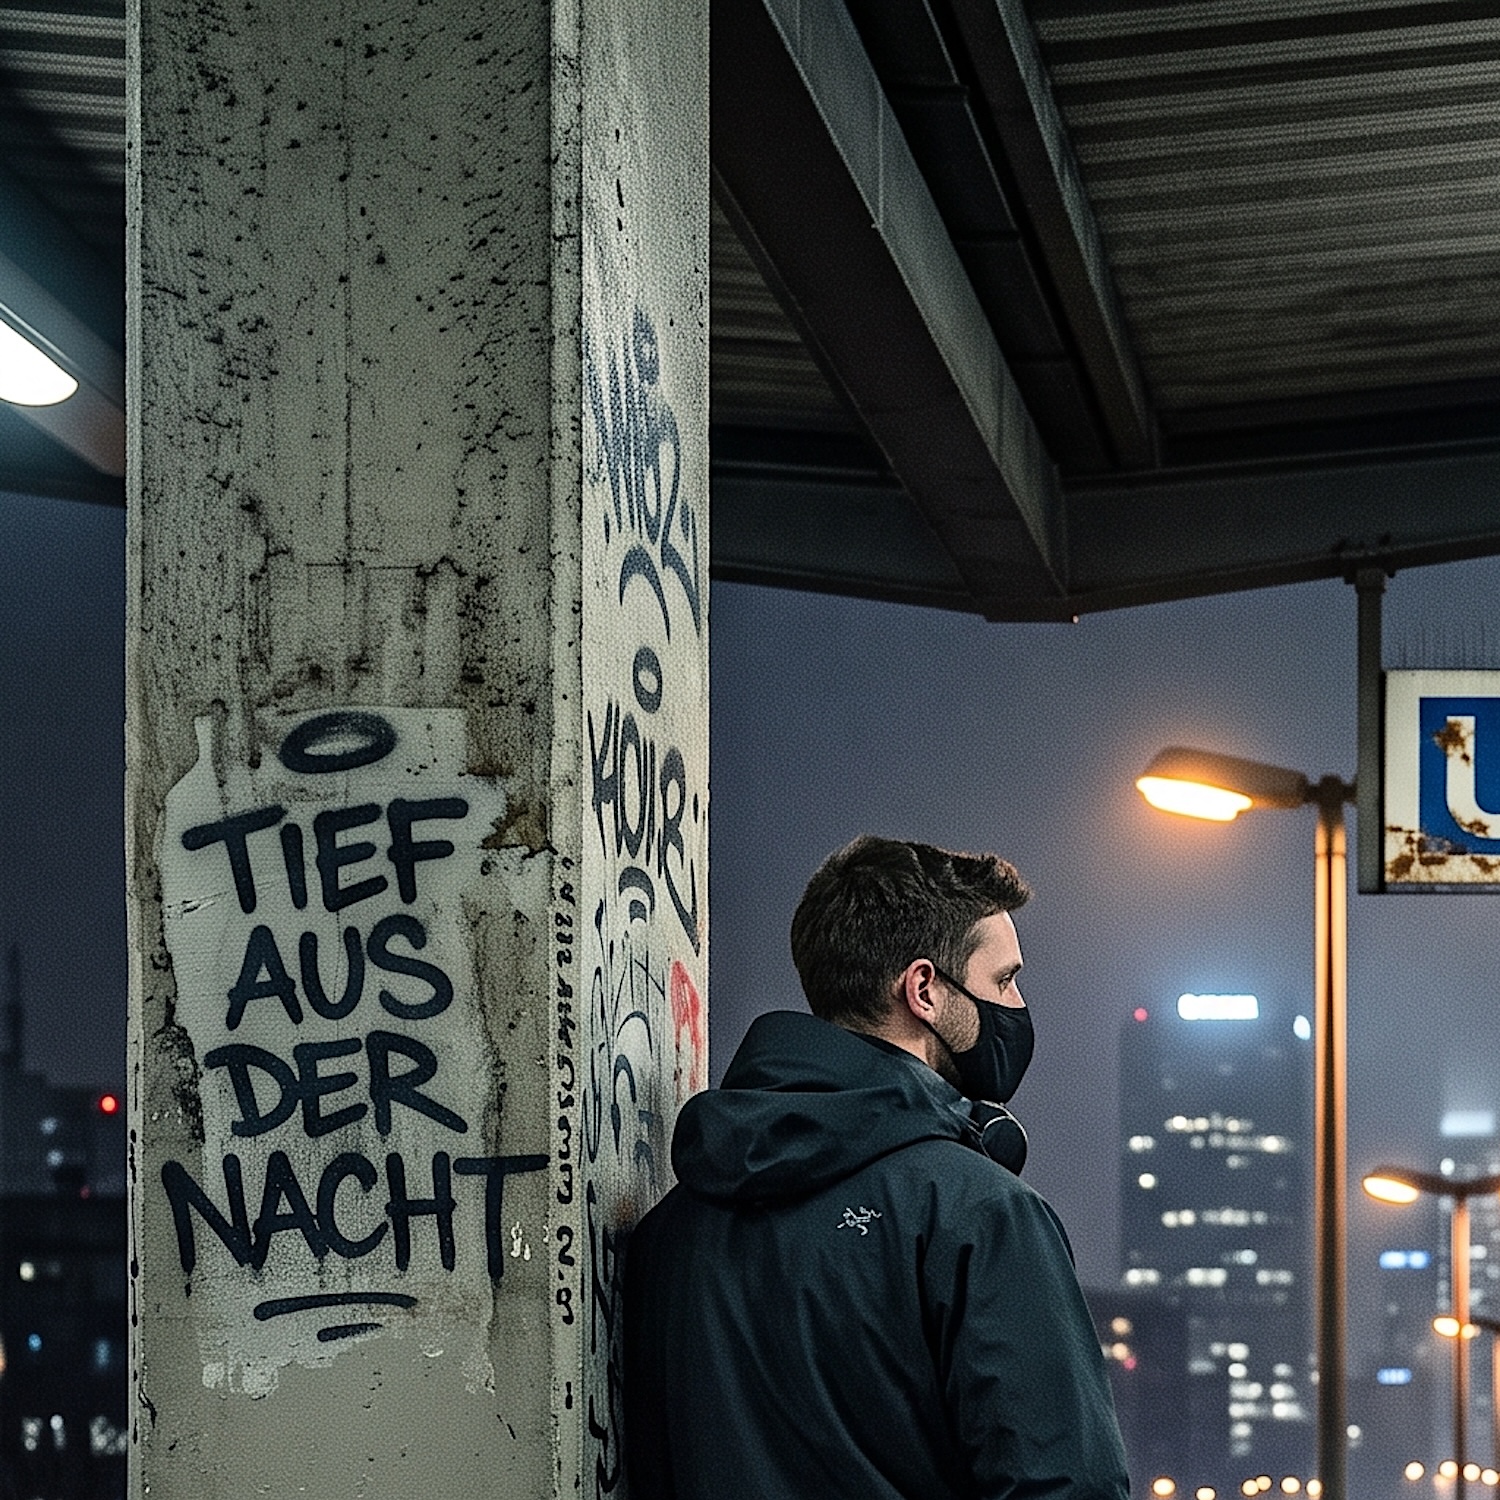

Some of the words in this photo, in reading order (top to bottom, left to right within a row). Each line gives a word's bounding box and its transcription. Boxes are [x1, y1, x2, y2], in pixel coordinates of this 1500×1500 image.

[181, 797, 468, 914] TIEF
[225, 914, 454, 1030] AUS
[204, 1030, 468, 1139] DER
[161, 1150, 550, 1284] NACHT
